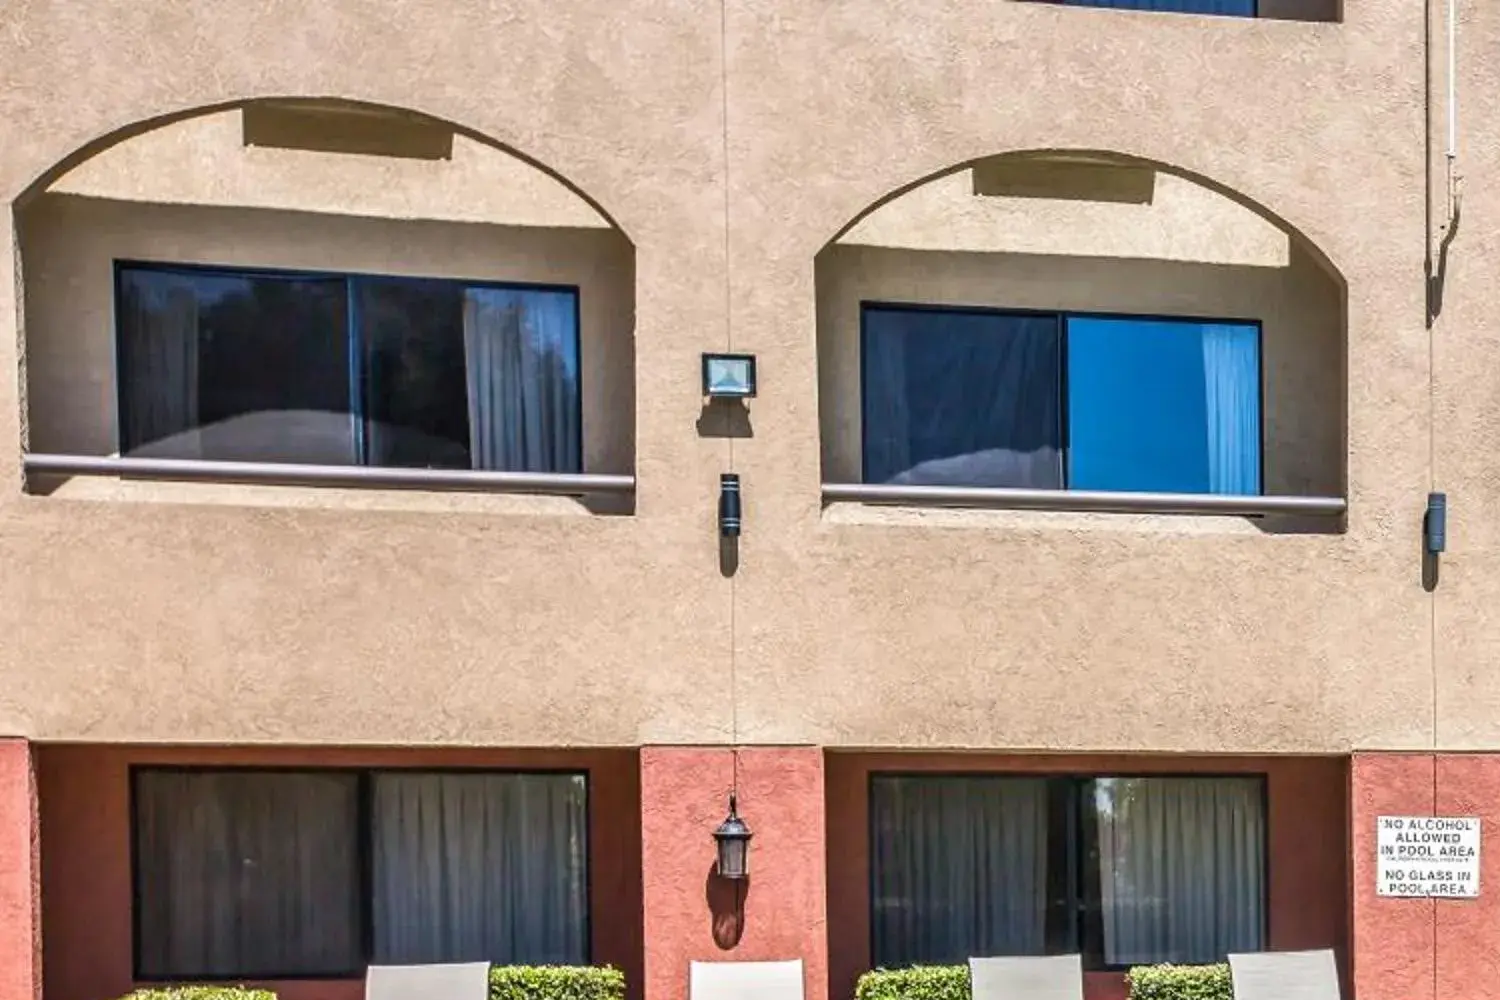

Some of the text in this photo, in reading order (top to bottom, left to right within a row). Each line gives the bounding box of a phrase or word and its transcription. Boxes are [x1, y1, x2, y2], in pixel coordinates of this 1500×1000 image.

[1384, 819, 1472, 831] NO ALCOHOL
[1396, 832, 1461, 843] ALLOWED
[1380, 846, 1475, 856] IN POOL AREA
[1385, 870, 1471, 881] NO GLASS IN
[1389, 883, 1467, 894] POOL AREA
